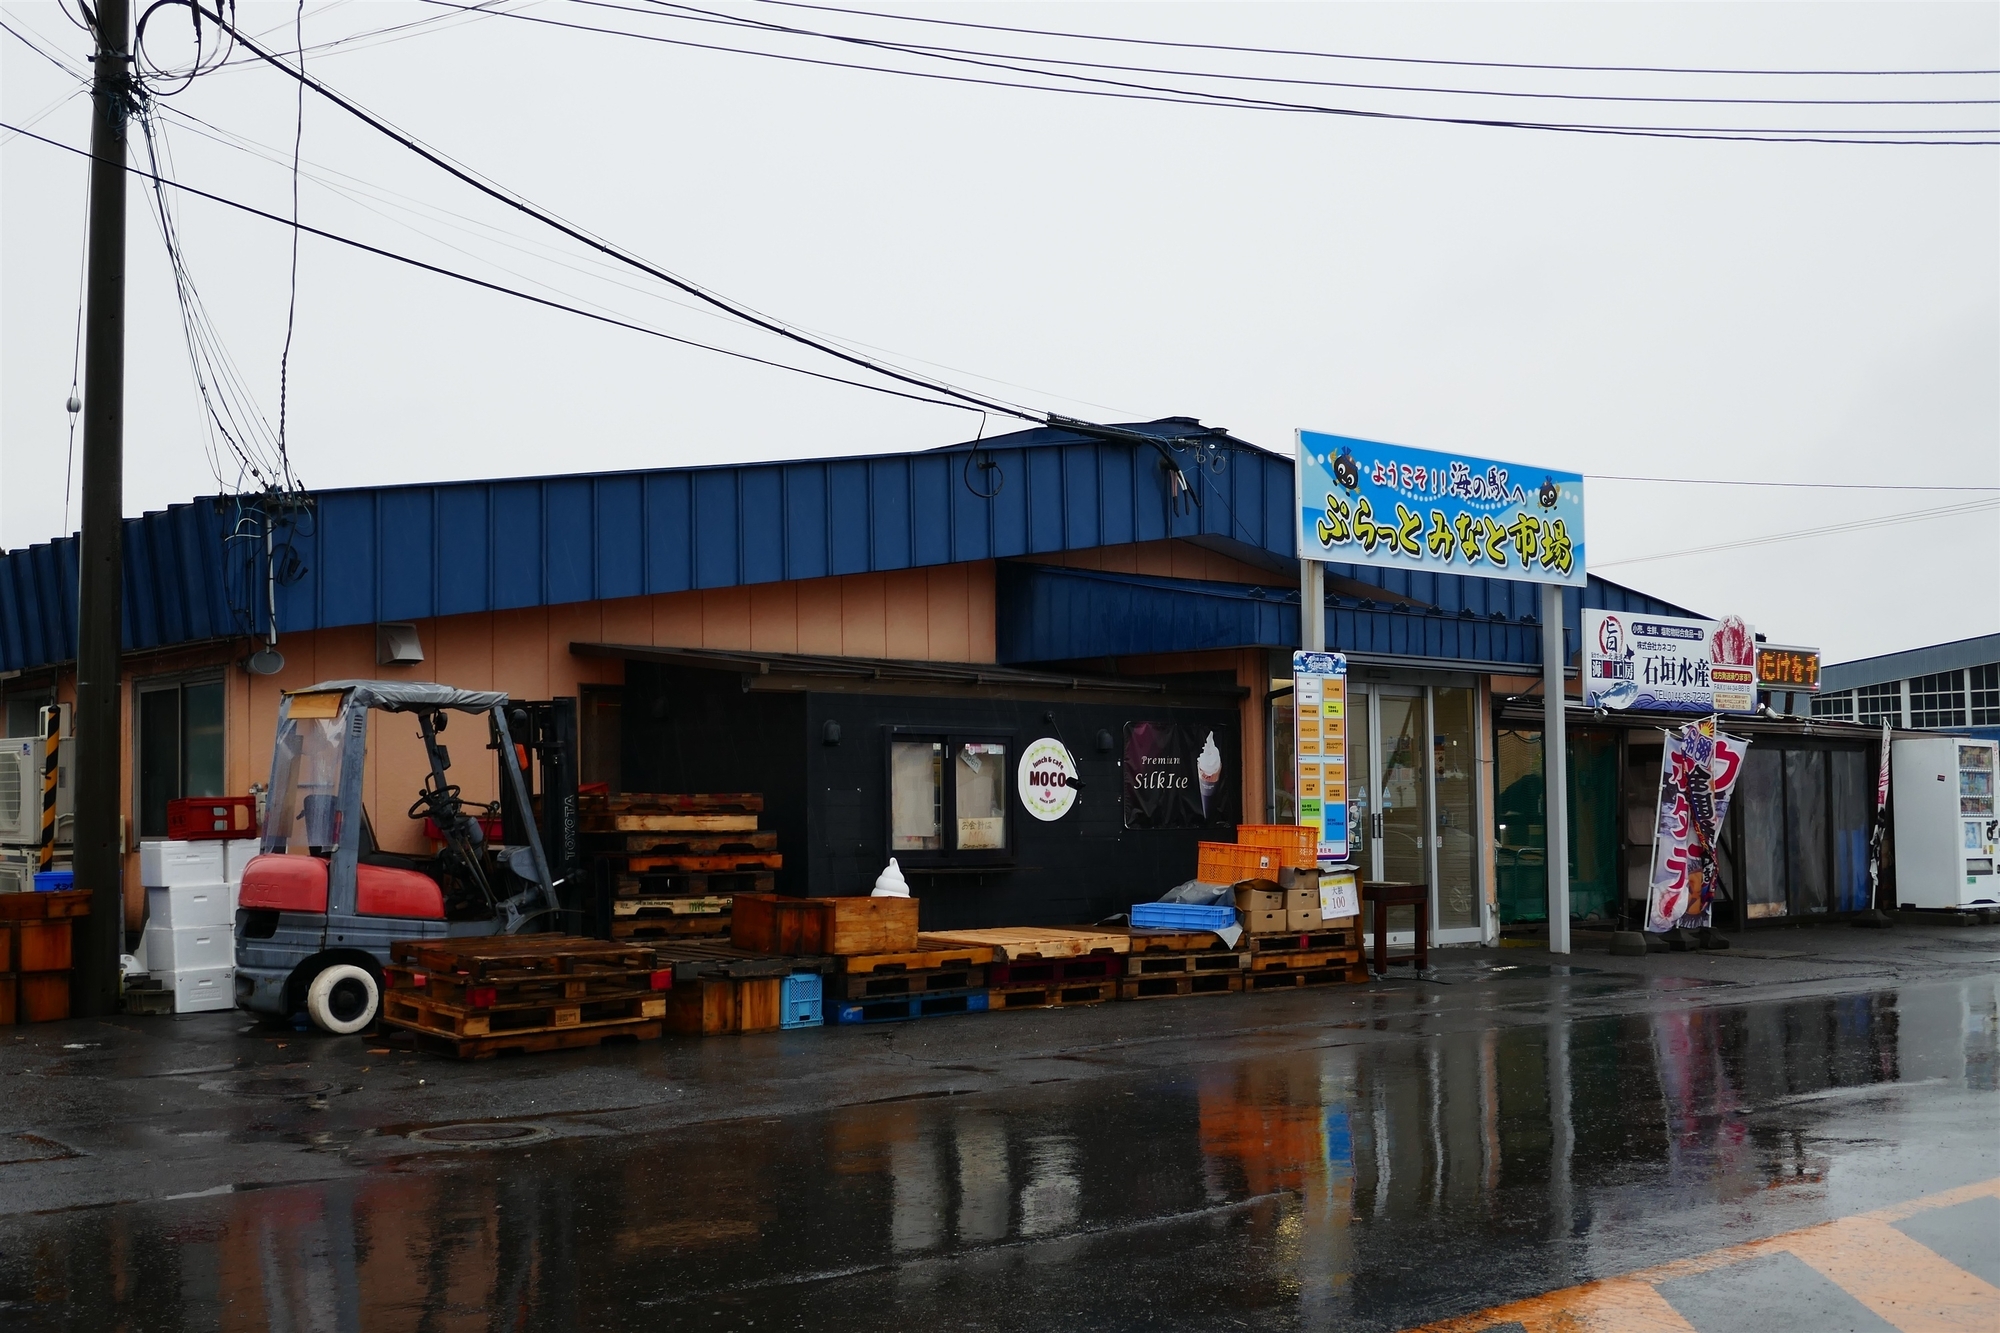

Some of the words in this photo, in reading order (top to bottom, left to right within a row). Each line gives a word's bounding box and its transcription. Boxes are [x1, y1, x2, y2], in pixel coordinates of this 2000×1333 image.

[1642, 654, 1711, 688] 石垣水産
[1654, 689, 1667, 700] TEL
[1668, 690, 1711, 702] 0144-36-7272
[1032, 756, 1047, 769] lunch
[1029, 770, 1066, 788] MOCO
[564, 794, 576, 861] TOYOTA
[1332, 896, 1346, 909] 100
